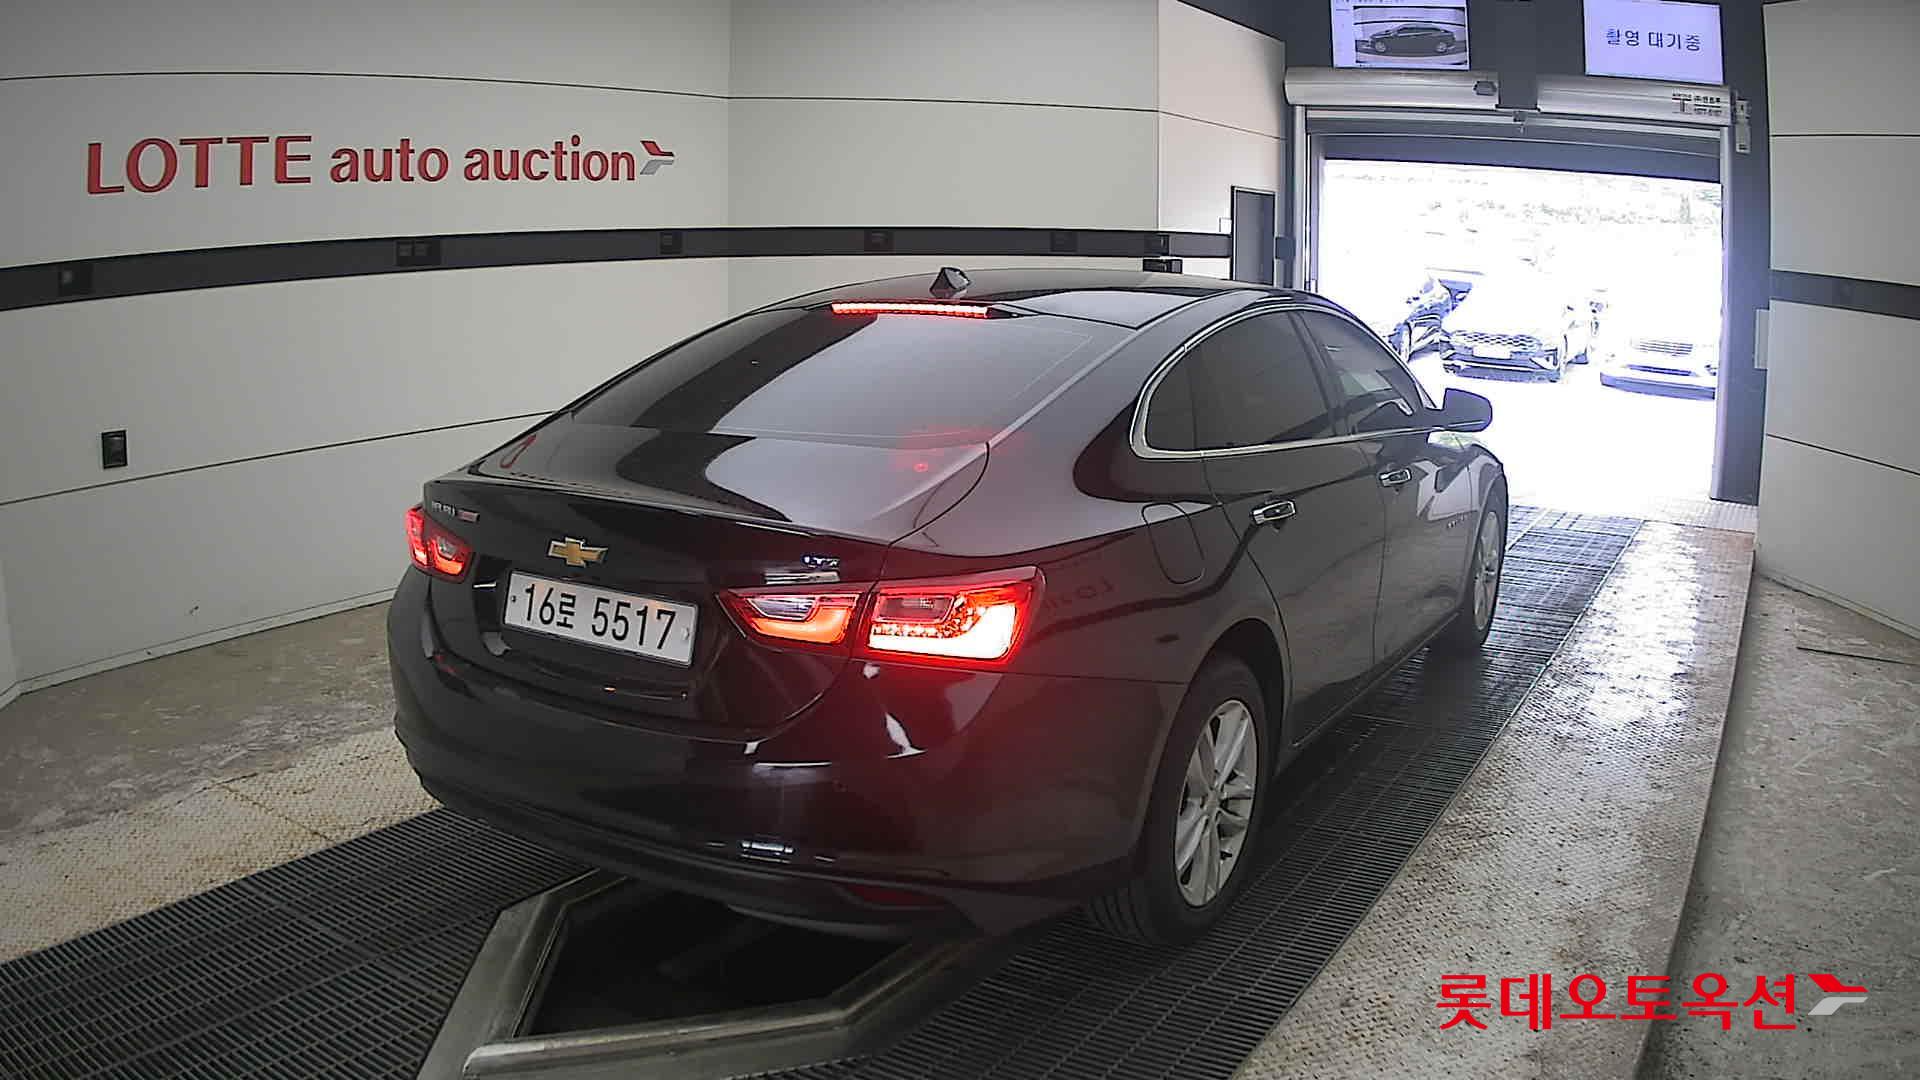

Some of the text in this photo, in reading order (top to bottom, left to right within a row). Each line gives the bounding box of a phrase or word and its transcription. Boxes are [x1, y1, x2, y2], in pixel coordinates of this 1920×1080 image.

[1648, 31, 1701, 51] 대기중
[87, 135, 636, 195] LOTTE auto auction
[525, 583, 676, 650] 16로 5517
